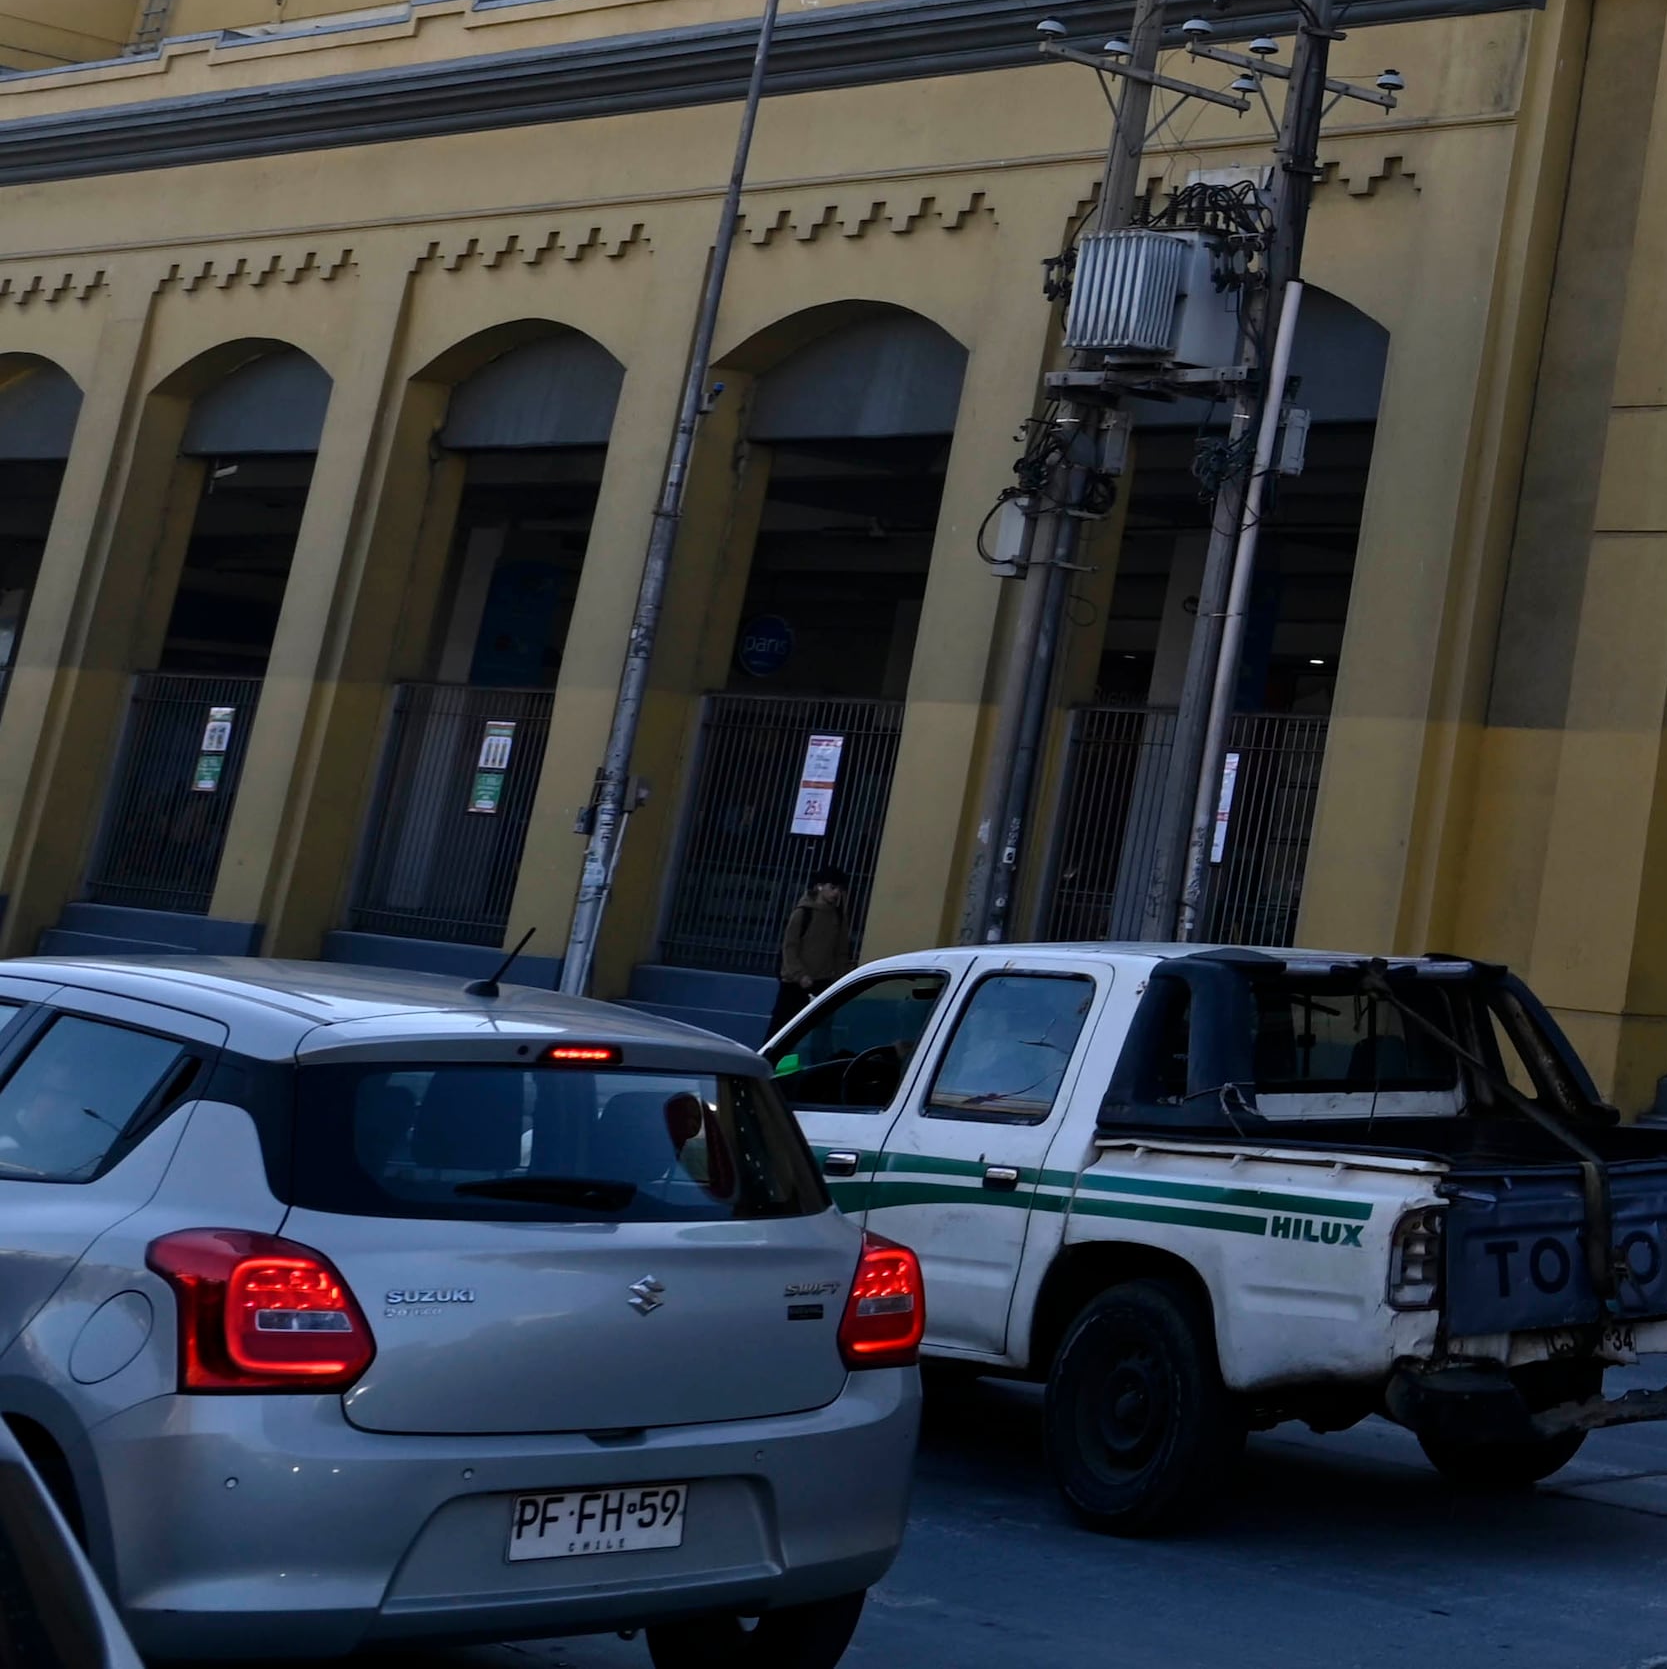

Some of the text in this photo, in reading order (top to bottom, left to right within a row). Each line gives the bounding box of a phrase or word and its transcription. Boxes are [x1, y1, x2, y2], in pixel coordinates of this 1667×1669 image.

[1271, 1215, 1365, 1248] HILUX
[386, 1289, 476, 1305] SUZUKI
[784, 1282, 841, 1297] SWIFT
[567, 1537, 627, 1553] CHILE
